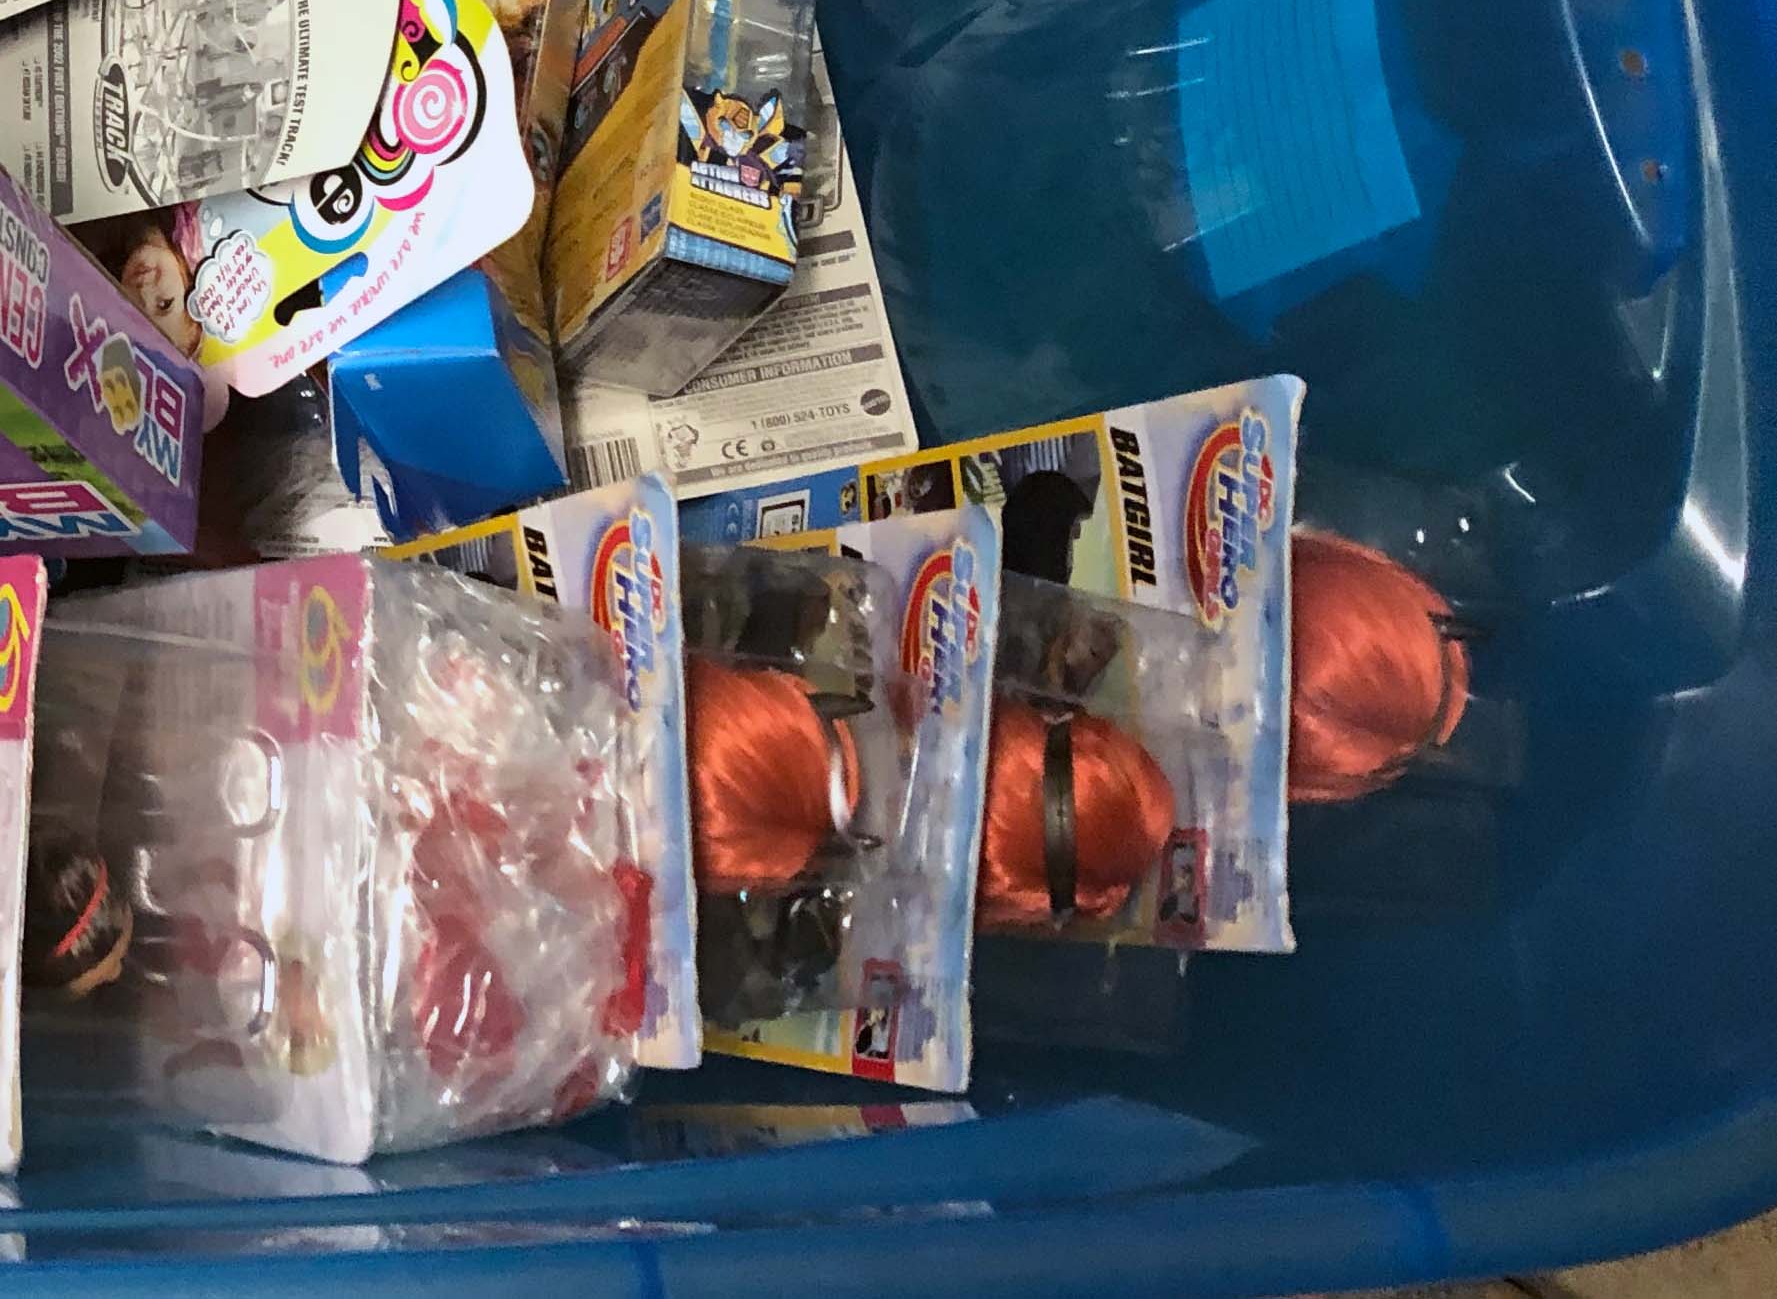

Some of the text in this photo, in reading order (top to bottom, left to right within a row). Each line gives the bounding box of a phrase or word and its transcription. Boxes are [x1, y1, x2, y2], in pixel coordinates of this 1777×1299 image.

[54, 24, 64, 39] THE
[54, 42, 64, 63] 2002
[296, 19, 308, 80] ULTIMATE
[54, 67, 64, 91] FIRST
[292, 84, 307, 114] TEST
[102, 82, 129, 165] TRACK
[275, 117, 302, 165] TRACK!
[682, 368, 757, 394] CONSUMER
[759, 349, 852, 379] INFORMATION
[759, 413, 791, 429] (800)
[792, 401, 851, 423] 524-TOYS
[138, 414, 178, 479] MY
[720, 438, 749, 460] CE
[1109, 427, 1157, 588] BATGIRL
[1237, 415, 1267, 568] SUPER
[1216, 469, 1239, 608] HERO
[627, 510, 654, 673] SUPER
[1206, 527, 1218, 620] GIRLS
[614, 569, 642, 712] HERO
